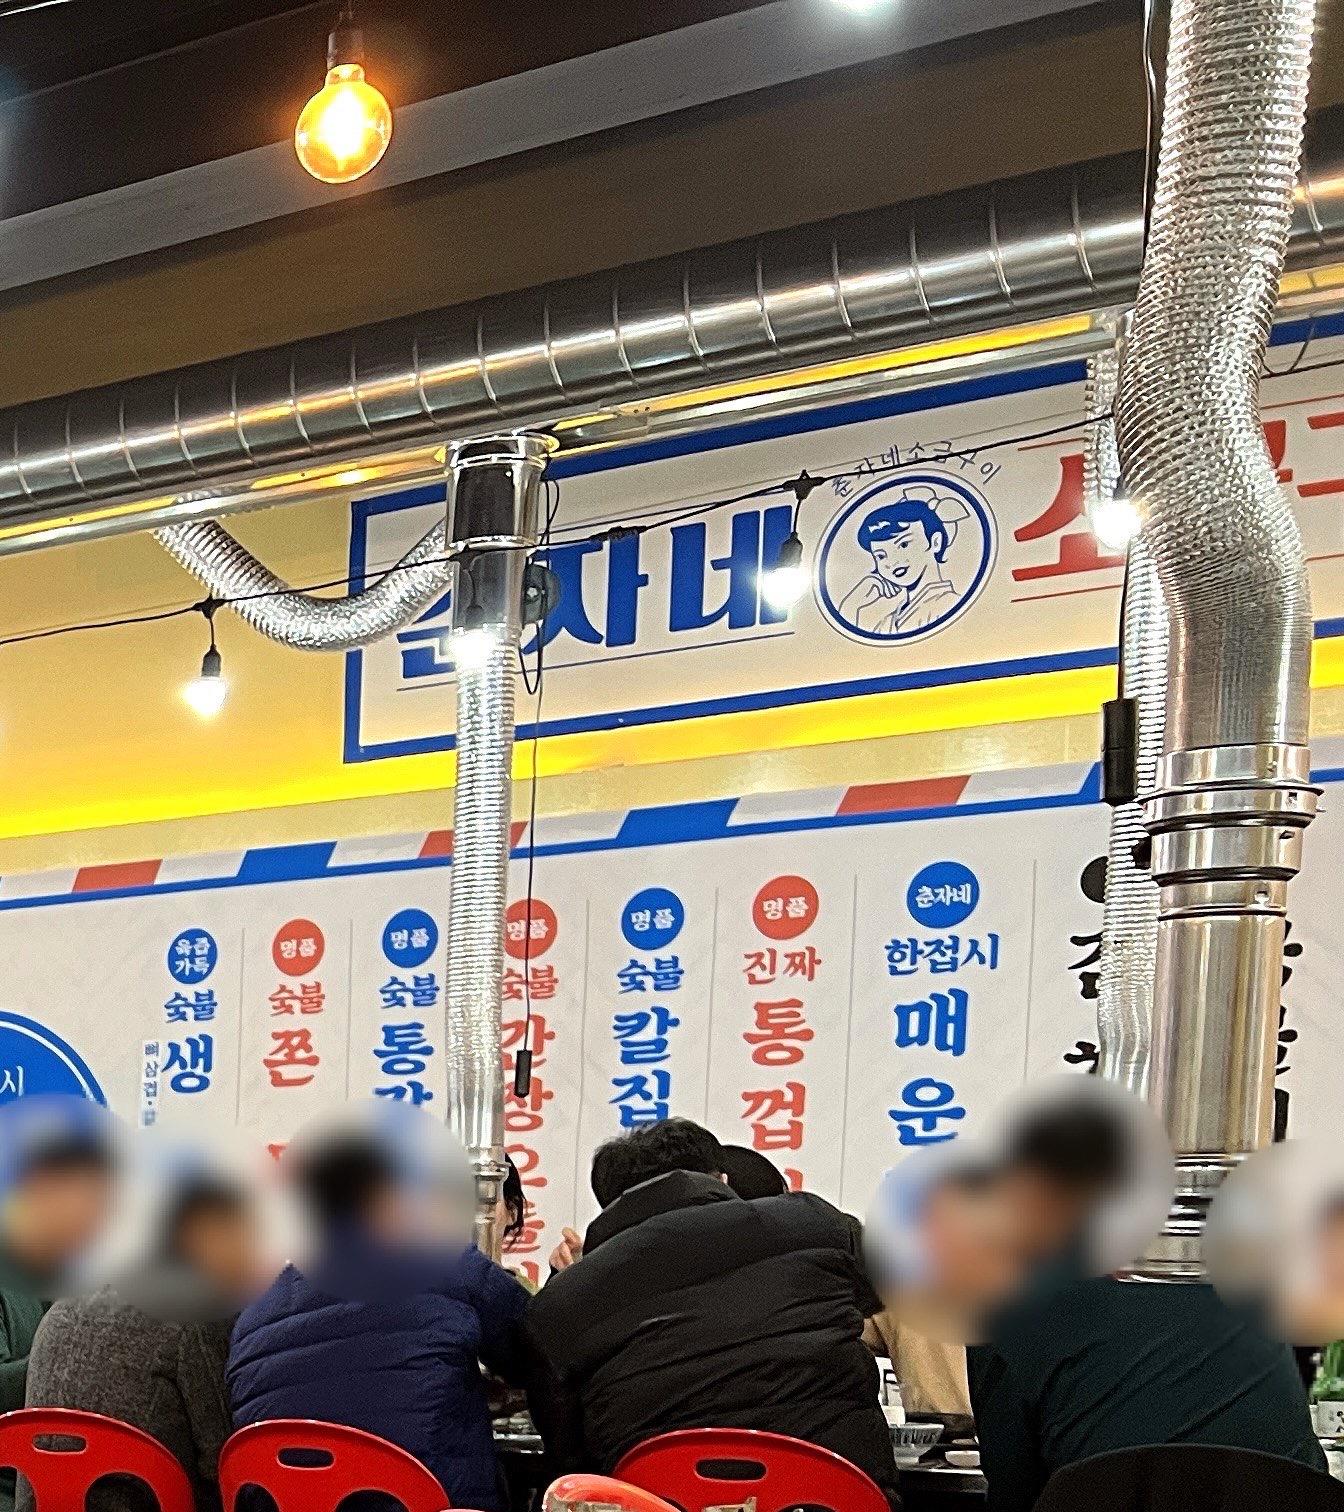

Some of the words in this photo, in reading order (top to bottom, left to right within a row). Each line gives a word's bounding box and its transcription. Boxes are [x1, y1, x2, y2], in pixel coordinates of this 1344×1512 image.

[762, 896, 810, 921] 명품
[915, 881, 973, 907] 춘자네
[390, 927, 431, 950] 명품
[630, 908, 676, 933] 명품
[279, 938, 318, 960] 명품
[742, 946, 823, 986] 진짜
[884, 932, 1001, 977] 한접시
[379, 973, 441, 1009] 숯불
[616, 955, 685, 994] 숯불
[164, 988, 218, 1024] 숯불
[268, 981, 326, 1017] 숯불
[740, 998, 815, 1192] 통껍
